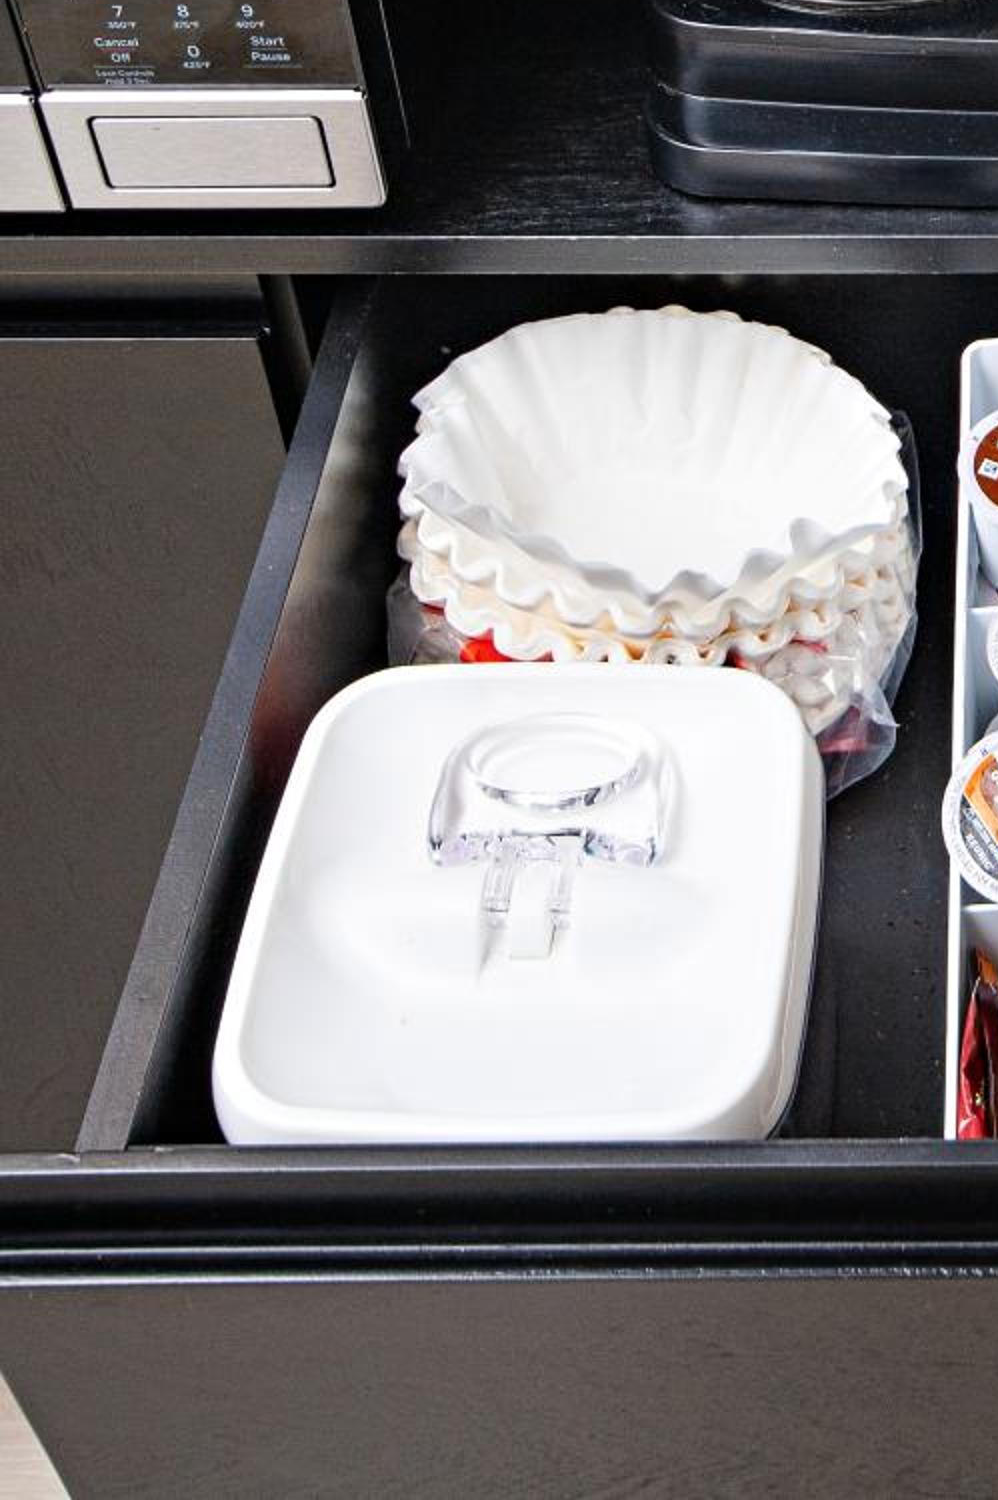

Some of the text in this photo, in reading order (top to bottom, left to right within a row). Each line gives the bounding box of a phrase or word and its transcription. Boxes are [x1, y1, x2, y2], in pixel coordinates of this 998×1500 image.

[111, 5, 123, 18] 7
[177, 4, 190, 18] 8
[241, 4, 253, 18] 9
[93, 37, 140, 48] Cancel
[250, 36, 285, 47] Start
[186, 45, 200, 58] 0
[250, 52, 291, 62] Pause
